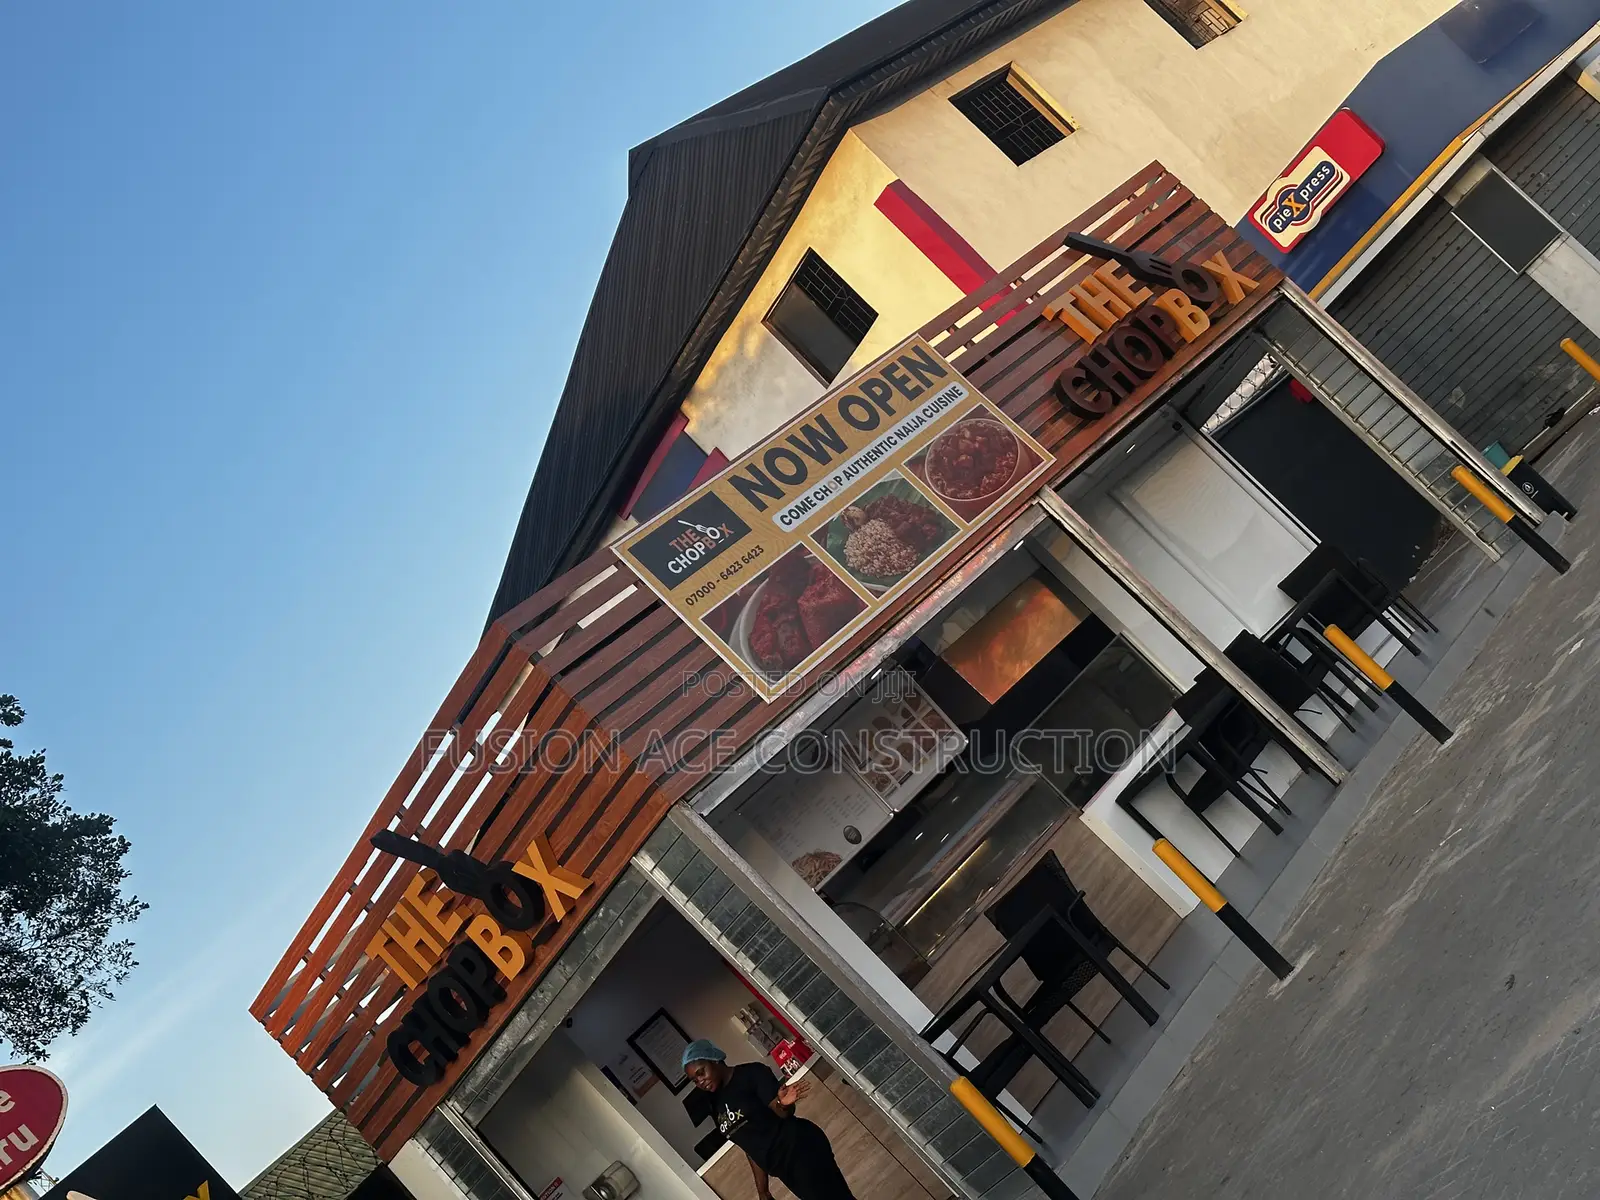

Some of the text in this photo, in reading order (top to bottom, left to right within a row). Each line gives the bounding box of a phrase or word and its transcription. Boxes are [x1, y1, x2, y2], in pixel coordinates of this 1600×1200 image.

[1042, 258, 1154, 345] THE
[727, 344, 949, 513] NOW OPEN
[779, 385, 964, 526] COME CHOP AUTHENTIC NAIJA CUISINE
[669, 528, 701, 552] THE
[685, 580, 716, 606] 07000
[721, 560, 743, 581] 6423
[741, 545, 765, 565] 6423
[364, 866, 474, 991] THE
